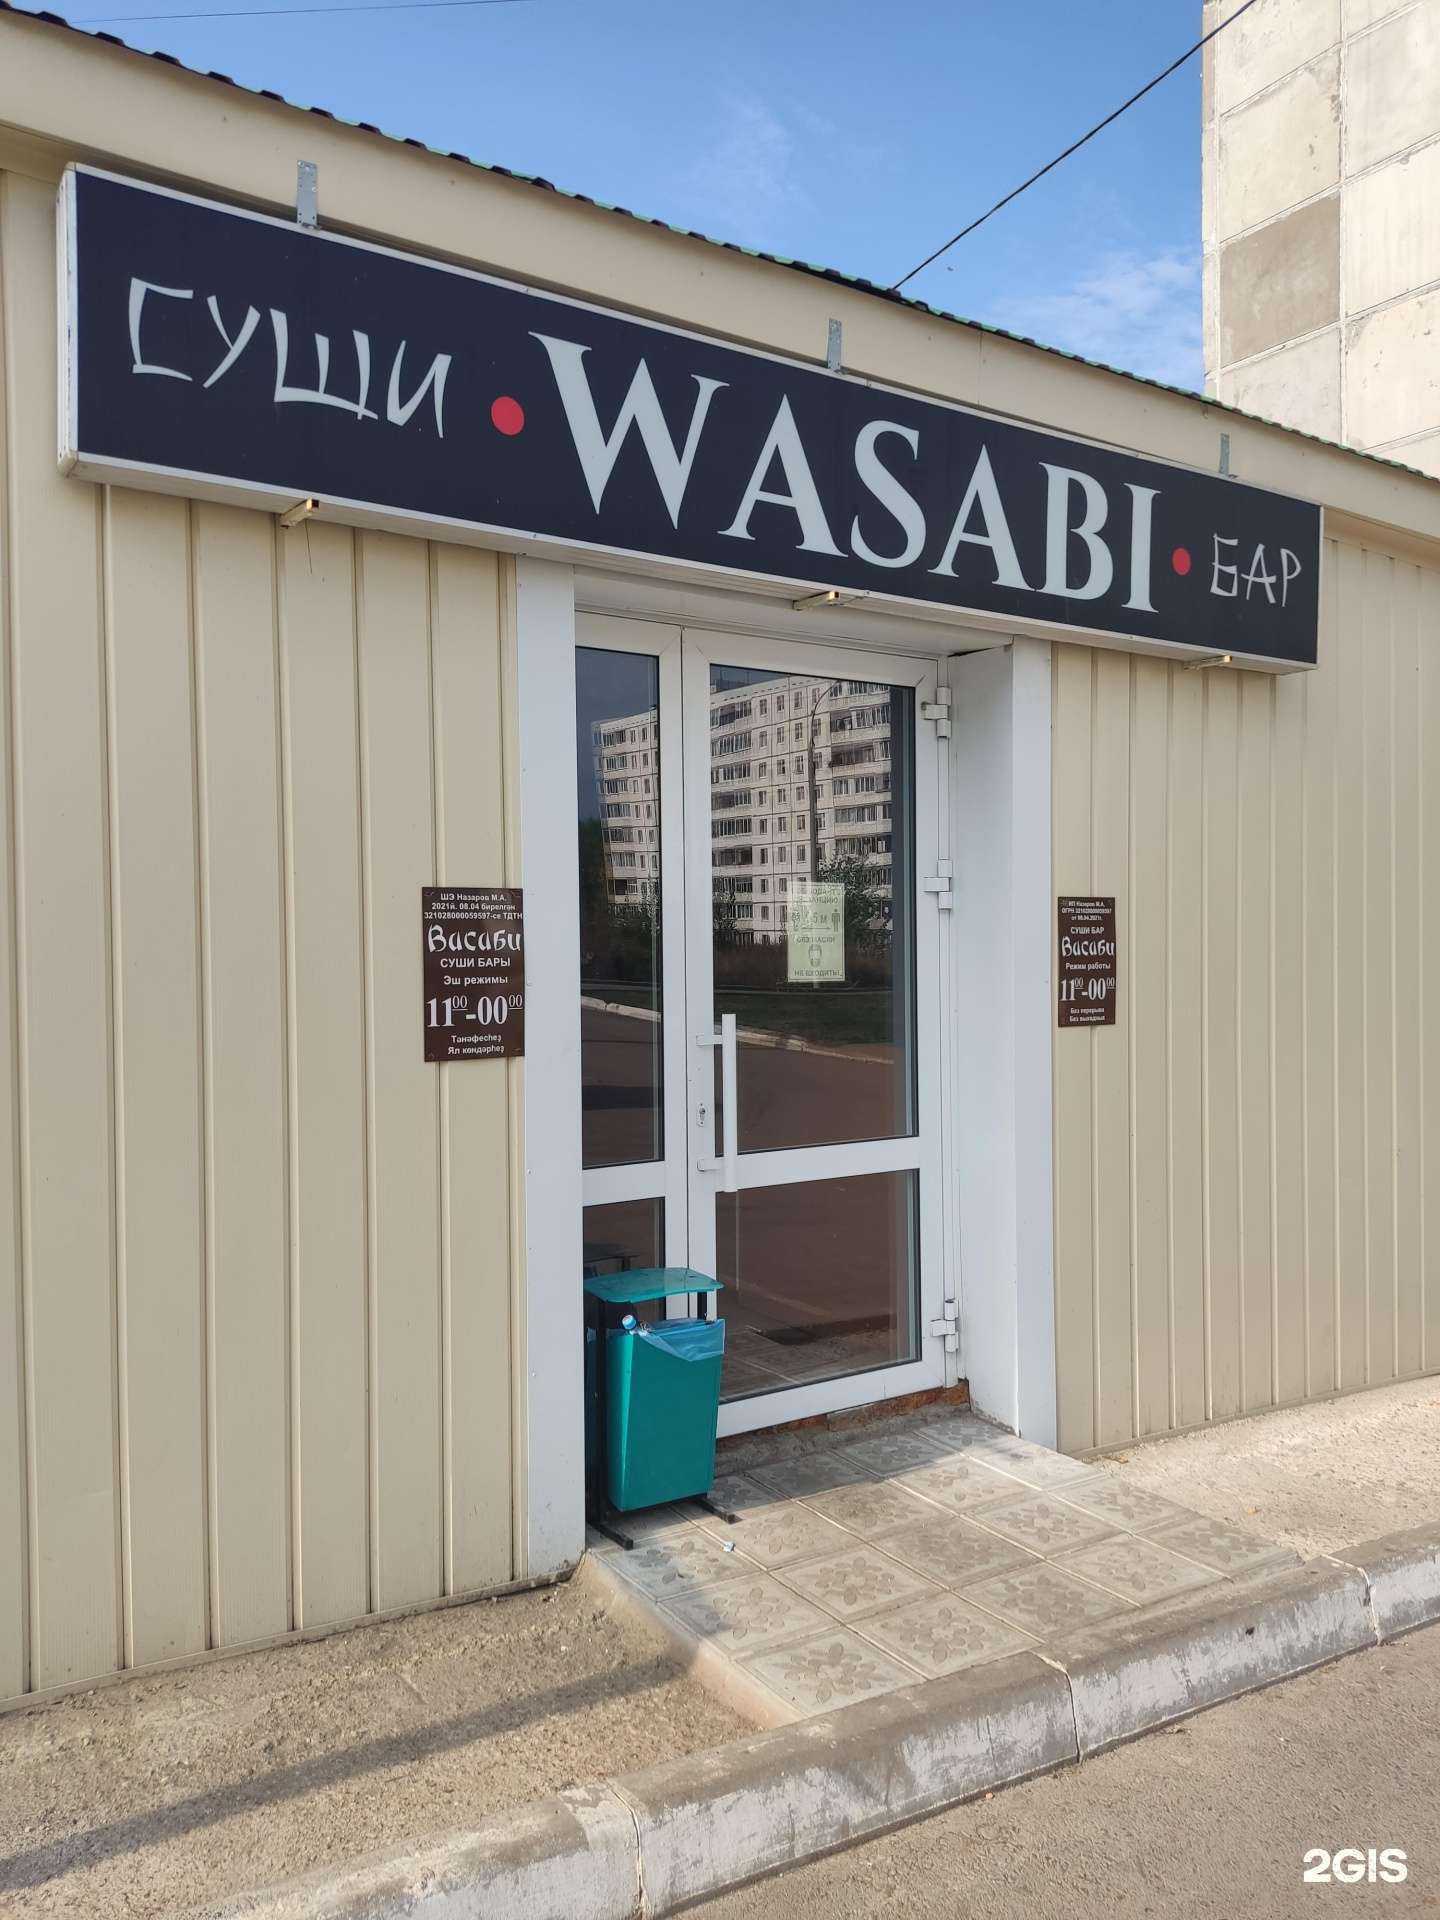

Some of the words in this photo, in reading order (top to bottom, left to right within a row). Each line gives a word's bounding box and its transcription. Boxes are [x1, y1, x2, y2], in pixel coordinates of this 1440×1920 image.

[128, 276, 452, 440] СУШИ
[527, 330, 1161, 614] WASABI
[1209, 533, 1301, 607] БАР
[428, 924, 521, 953] Васаби
[1091, 926, 1105, 934] БАР
[1061, 935, 1115, 957] Васаби
[440, 958, 475, 968] СУШИ
[477, 957, 511, 967] БАРЫ
[1087, 962, 1111, 971] работы
[443, 975, 461, 985] Эш
[464, 976, 508, 987] режимы
